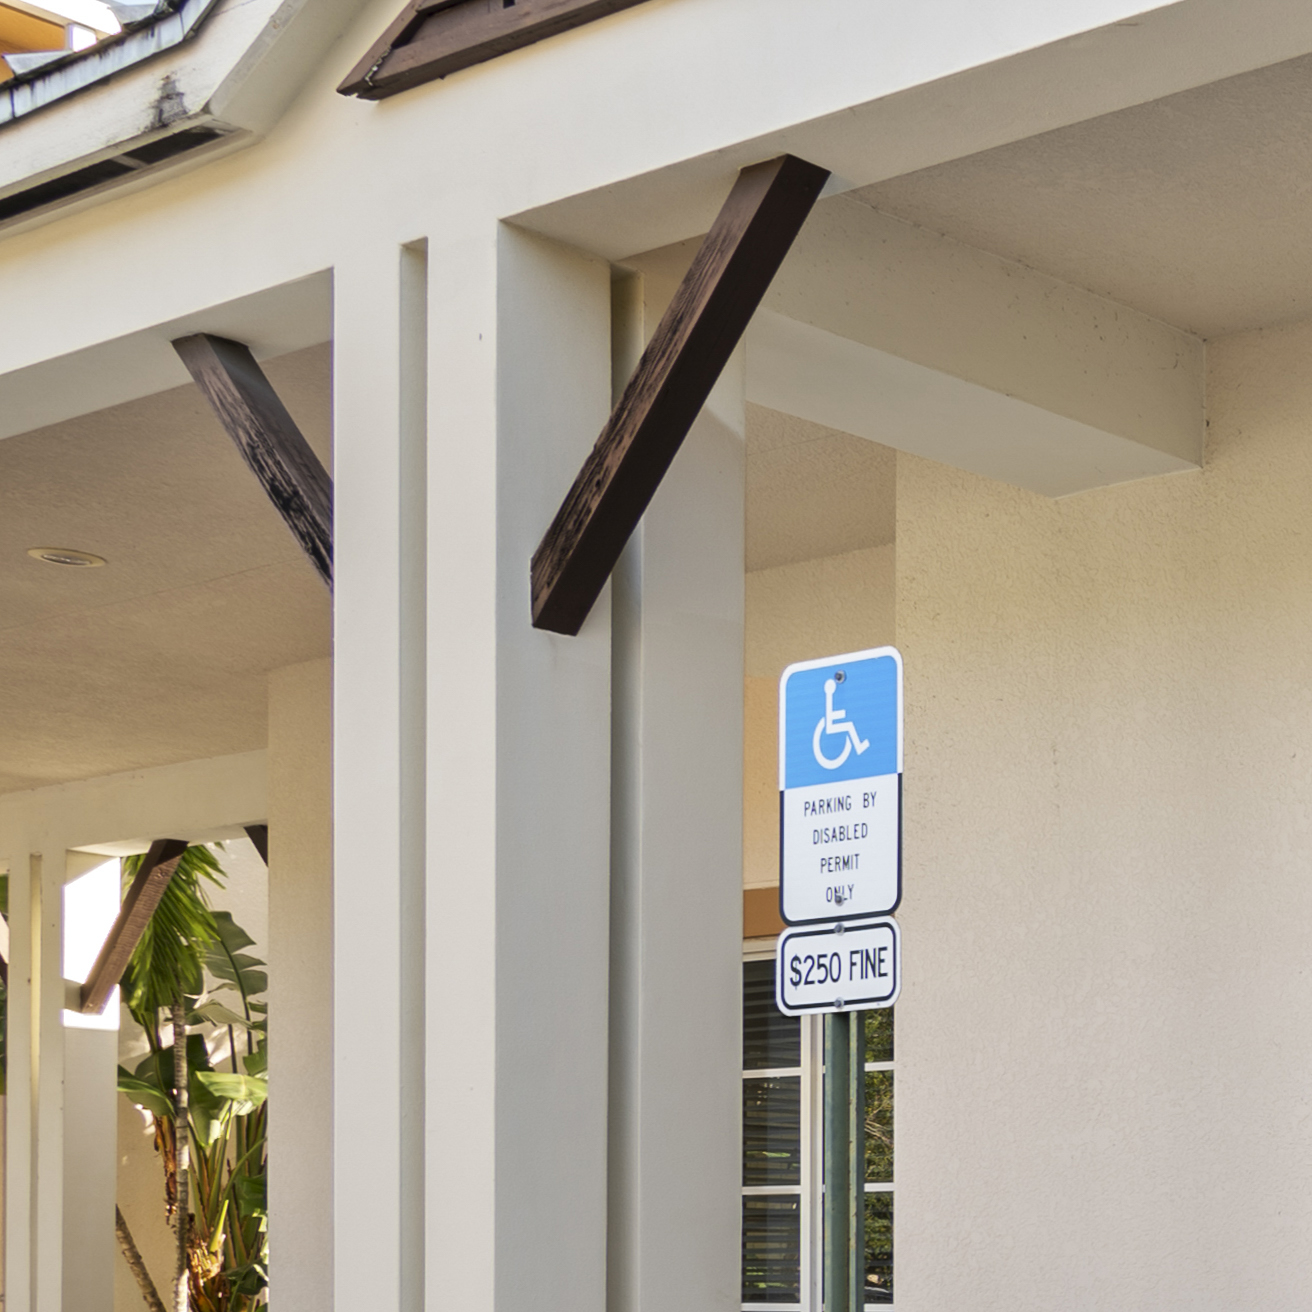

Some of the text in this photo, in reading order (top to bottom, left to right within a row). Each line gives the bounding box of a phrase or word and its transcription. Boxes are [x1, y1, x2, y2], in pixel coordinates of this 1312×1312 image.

[804, 791, 878, 817] PARKING BY
[813, 823, 869, 845] DISABLED
[820, 853, 860, 873] PERMIT
[826, 883, 855, 903] ONLY
[789, 946, 889, 990] $250 FINE
